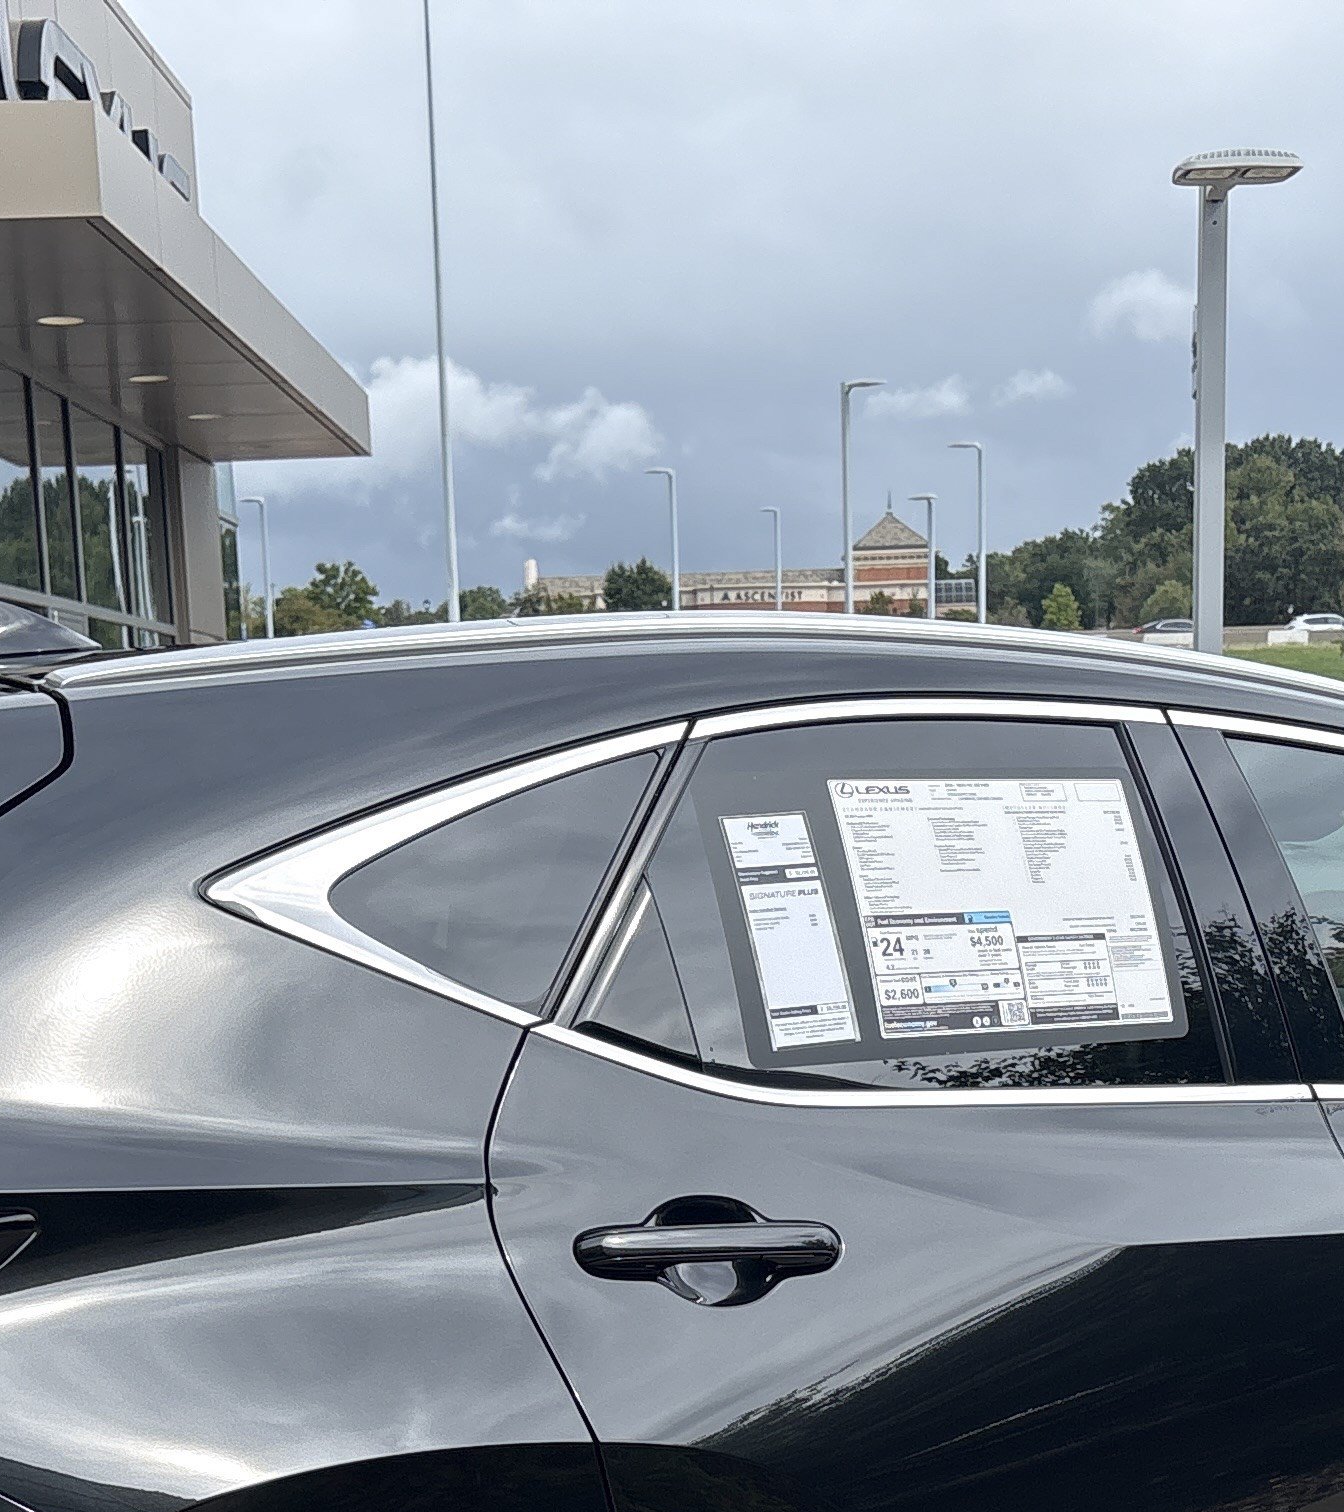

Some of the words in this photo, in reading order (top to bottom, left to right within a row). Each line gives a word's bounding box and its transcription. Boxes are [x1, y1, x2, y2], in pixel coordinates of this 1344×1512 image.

[735, 590, 803, 601] ASCENIST
[855, 785, 910, 795] LEXUS
[746, 820, 780, 832] Hendrick
[749, 889, 797, 900] SIGNATURE
[797, 888, 819, 897] PLUS
[877, 917, 889, 925] Fuel
[889, 917, 914, 926] Economy
[879, 936, 905, 957] 24
[969, 935, 1004, 948] $4,500
[884, 988, 920, 1001] $2,600
